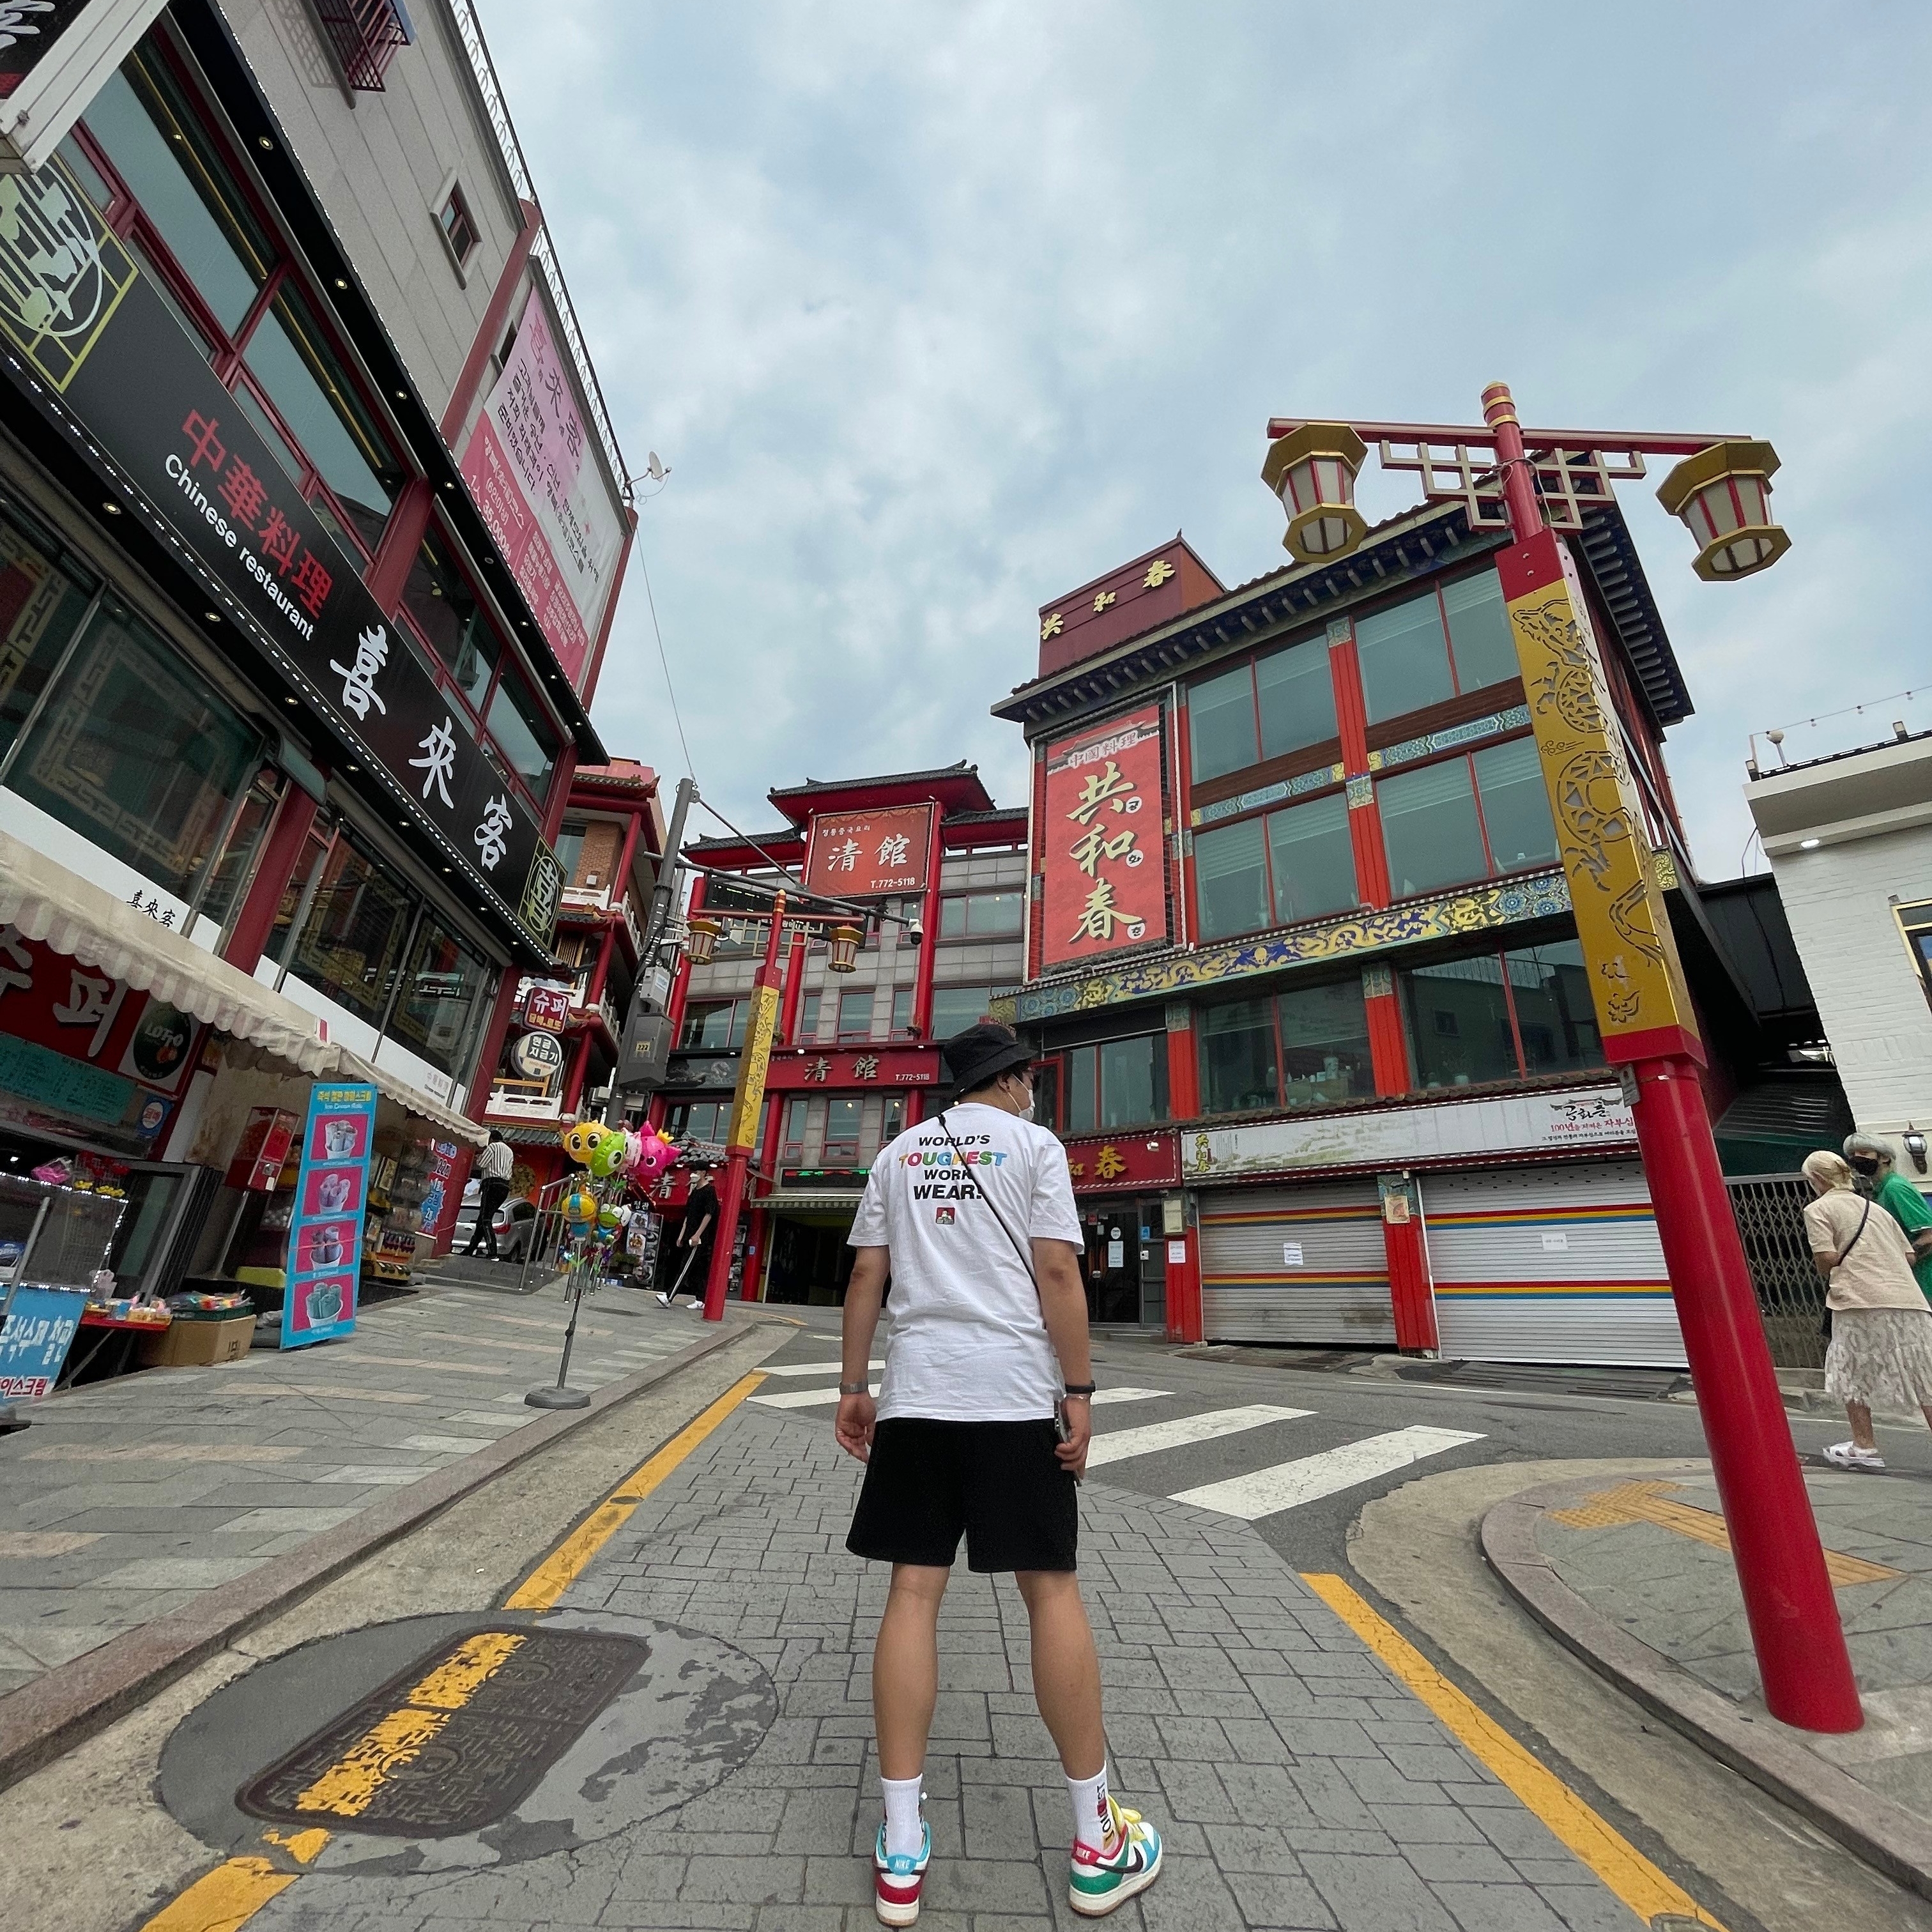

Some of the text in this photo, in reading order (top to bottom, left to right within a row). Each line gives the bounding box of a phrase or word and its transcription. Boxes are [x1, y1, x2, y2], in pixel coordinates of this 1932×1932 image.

[518, 358, 545, 434] 고객님들께
[529, 313, 581, 458] 喜來客
[497, 402, 535, 494] 준비했습니다.
[507, 387, 520, 422] 저희
[519, 422, 543, 482] 희래객이
[512, 372, 528, 422] 즐거운
[530, 423, 542, 454] 송년
[546, 463, 560, 491] 신년
[182, 408, 334, 620] 中華料理
[486, 477, 509, 525] (6인이상)
[164, 453, 315, 641] Chinese restaurant
[483, 499, 511, 560] 35,000원
[1039, 558, 1176, 641] 共和春
[329, 623, 514, 871] 喜來客
[1070, 732, 1136, 767] 中國料理
[822, 824, 871, 837] 정통중국요리
[827, 832, 911, 873] 清館
[1065, 761, 1145, 945] 共和春
[870, 877, 916, 889] T.772-5118
[534, 990, 567, 1020] 슈퍼
[529, 1046, 558, 1064] 지급기
[533, 1036, 551, 1050] 현금
[804, 1054, 880, 1082] 清館
[1563, 1101, 1606, 1121] 공화춘
[898, 1151, 1008, 1169] TOUGHEST
[919, 1135, 990, 1146] WORLD'S
[895, 1859, 911, 1869] NIKE
